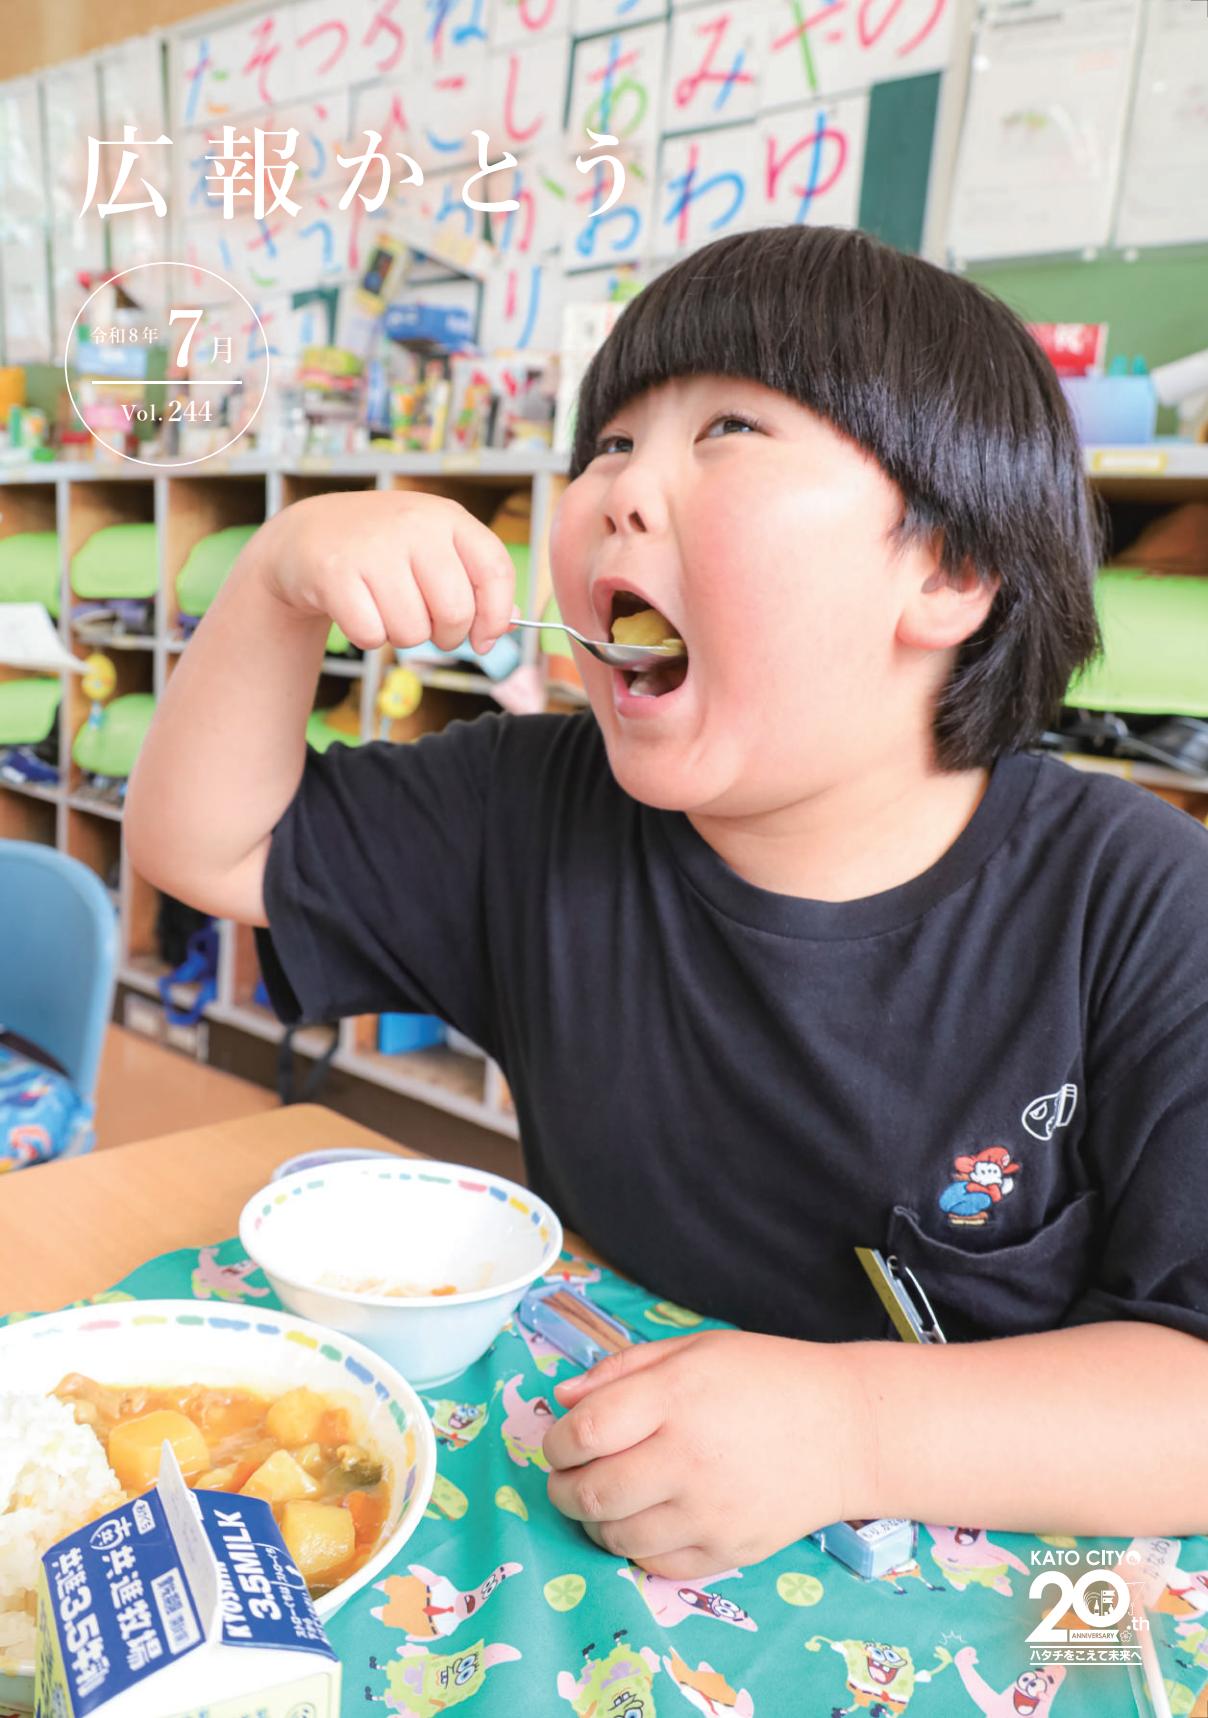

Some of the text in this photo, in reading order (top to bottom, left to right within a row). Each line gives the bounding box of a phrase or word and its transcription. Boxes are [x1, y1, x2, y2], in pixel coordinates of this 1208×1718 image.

[673, 14, 755, 110] み
[665, 143, 746, 249] わ
[764, 108, 849, 226] ゆ
[52, 1547, 110, 1698] 共進3.5牛乳
[102, 1545, 164, 1672] 共進牧場
[213, 1509, 283, 1621] 3.5MILK
